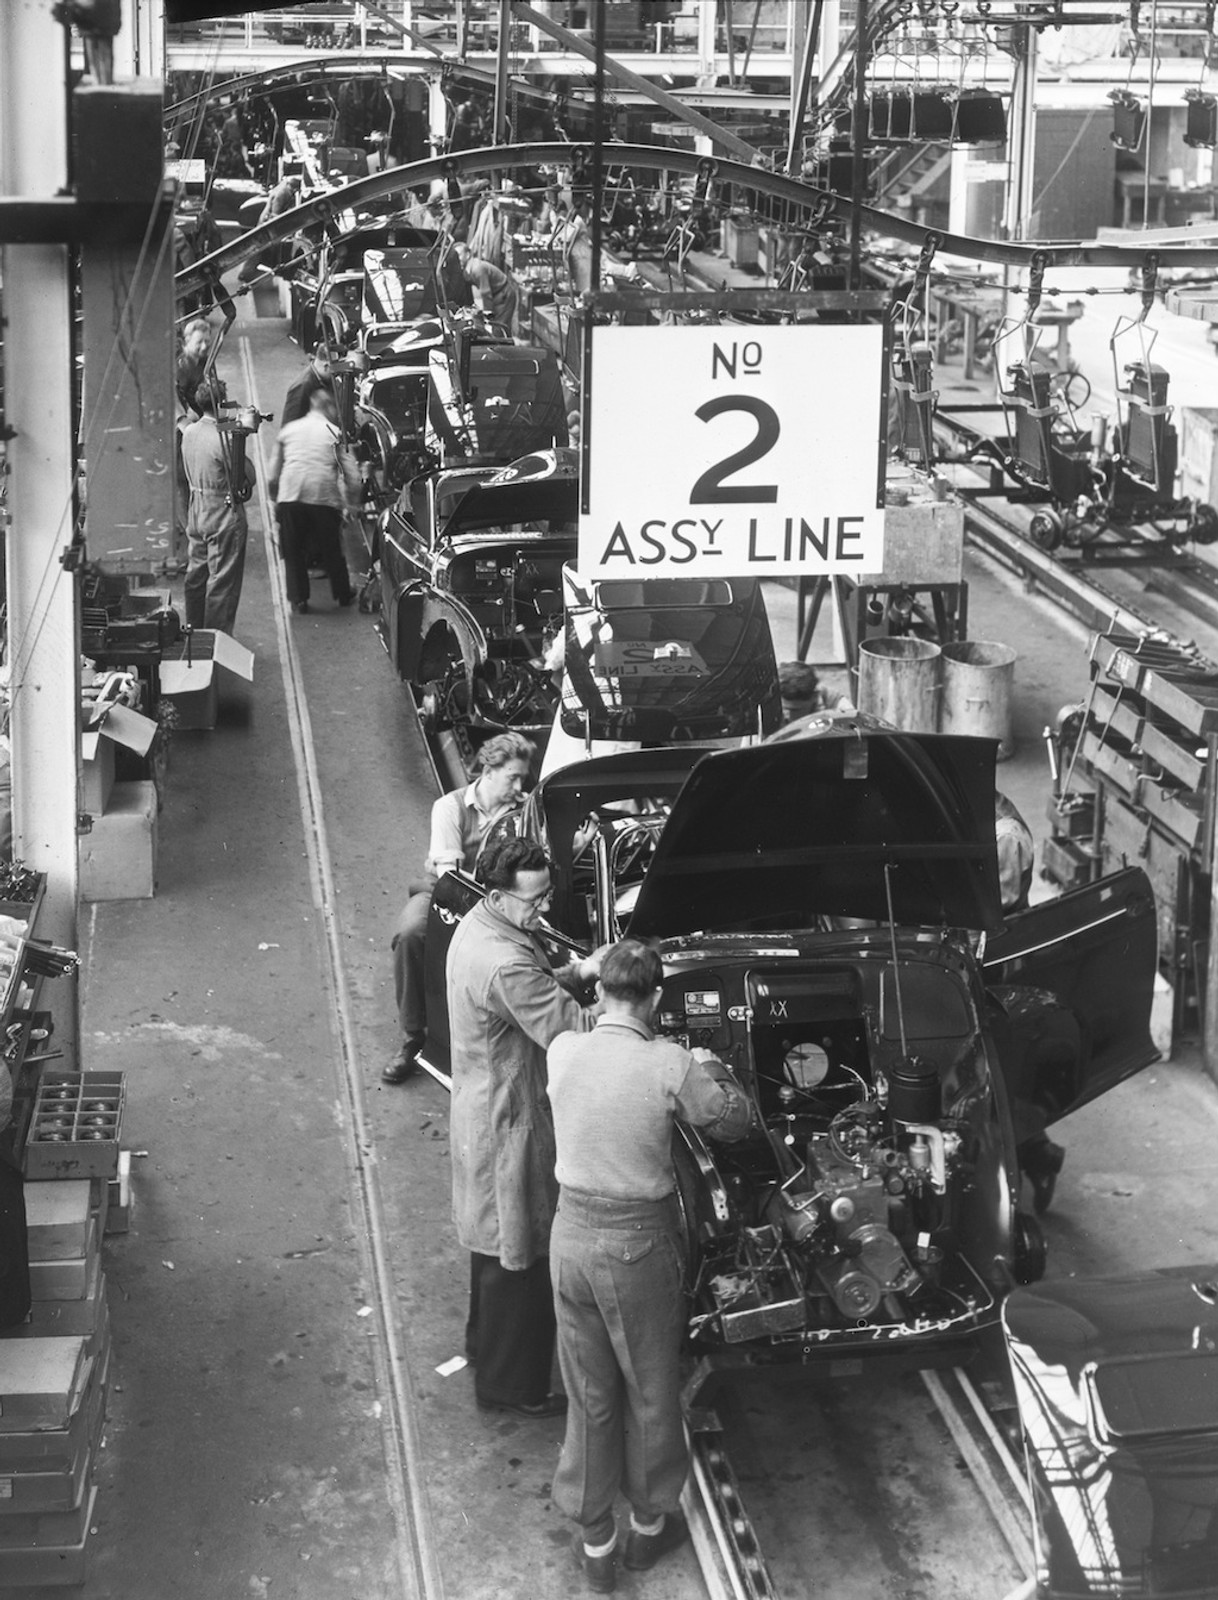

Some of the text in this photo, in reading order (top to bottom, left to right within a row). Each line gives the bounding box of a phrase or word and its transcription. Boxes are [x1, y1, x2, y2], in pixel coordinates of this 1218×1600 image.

[689, 394, 781, 505] 2
[599, 516, 864, 565] ASSY LINE
